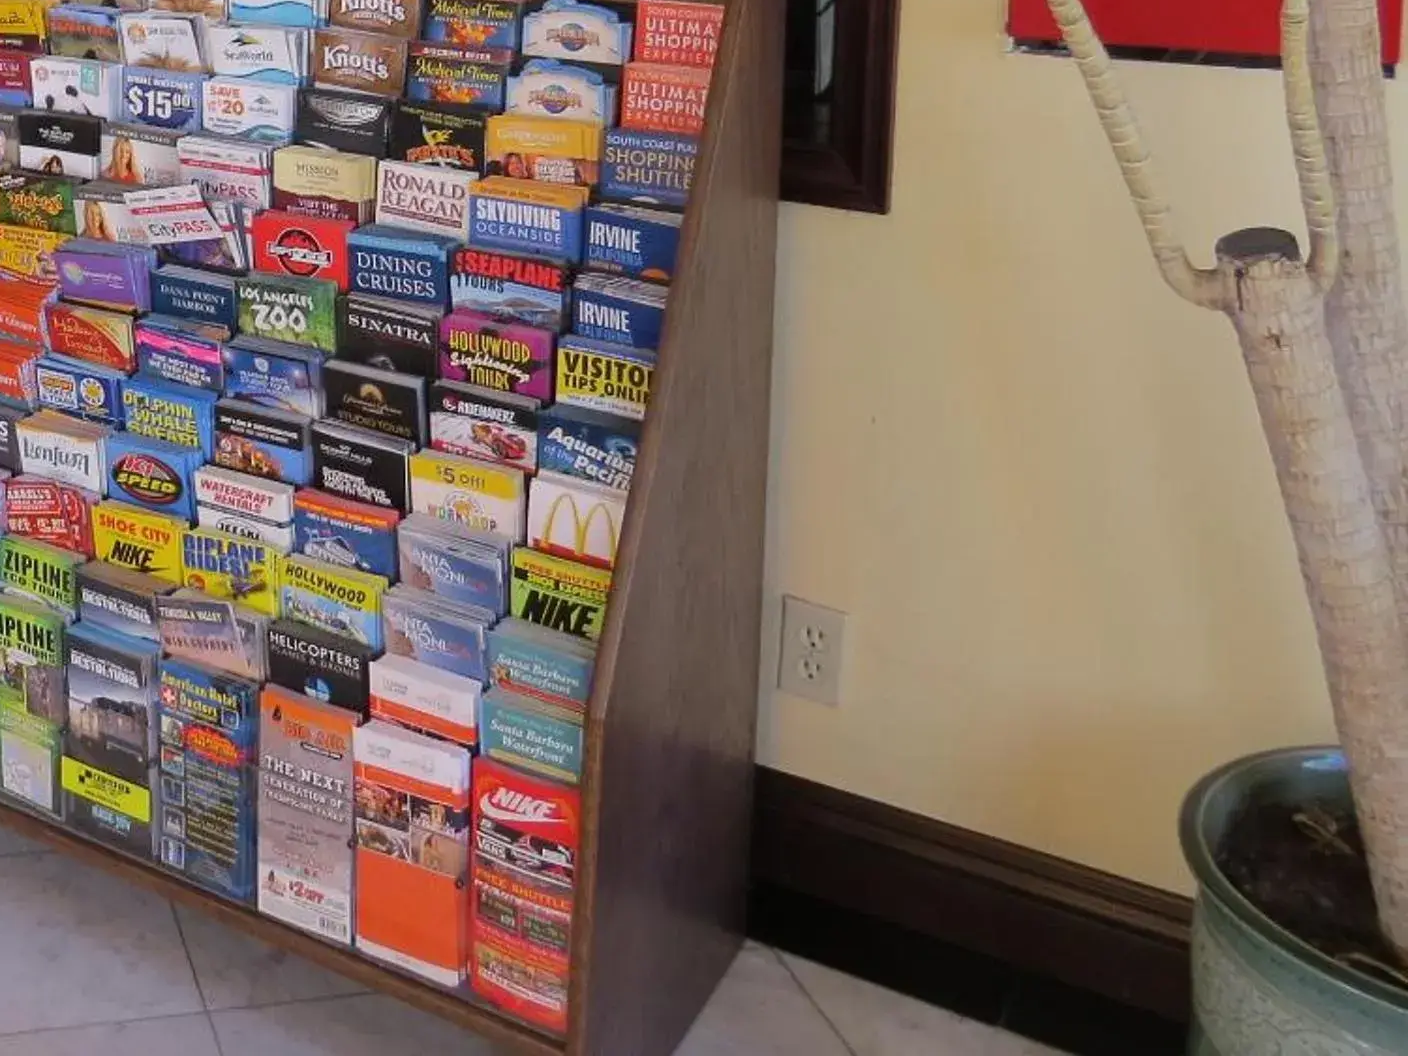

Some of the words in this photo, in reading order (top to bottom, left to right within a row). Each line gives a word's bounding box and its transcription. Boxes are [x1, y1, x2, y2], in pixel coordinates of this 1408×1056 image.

[645, 17, 722, 37] ULTIMA
[224, 48, 274, 62] SeaWorld
[324, 44, 389, 79] Knott's
[607, 134, 641, 146] SOUTH
[383, 169, 465, 198] RONALD
[616, 167, 692, 190] SHUTTLE
[382, 191, 464, 219] REAGAN
[476, 198, 561, 232] SKYDIVING
[148, 219, 213, 237] CityPASS
[476, 220, 561, 244] OCEANSIDE
[589, 220, 641, 253] IRVINE
[357, 252, 432, 277] DINING
[465, 250, 564, 291] SEAPLANE
[192, 290, 227, 306] POINT
[239, 286, 260, 301] LOS
[263, 292, 314, 311] ANGELES
[357, 273, 437, 297] CRUISES
[251, 304, 308, 333] ZOO
[348, 313, 431, 345] SINATRA
[578, 300, 631, 332] IRVINE
[449, 328, 531, 362] HOLLYWOOD
[470, 365, 511, 391] TOURS
[563, 373, 598, 393] TIPS
[123, 390, 193, 418] DOLPHIN
[135, 408, 196, 434] WHALE
[547, 426, 635, 472] Aquarium
[116, 472, 177, 494] SPEED
[200, 478, 274, 506] WATERCRAFT
[213, 493, 262, 514] RENTALS
[99, 512, 137, 538] SHOE
[141, 526, 171, 545] CITY
[112, 540, 155, 569] NIKE
[2, 549, 72, 593] ZIPLINE
[3, 571, 28, 589] ECO
[285, 561, 367, 604] HOLLYWOOD
[521, 589, 599, 635] NIKE
[269, 630, 360, 670] HELICOPTERS
[497, 653, 529, 671] Santa
[531, 661, 579, 688] Barbara
[509, 666, 572, 696] Waterfront
[490, 717, 524, 740] Santa
[526, 728, 574, 754] Barbara
[502, 735, 567, 765] Waterfront
[264, 754, 294, 778] THE
[300, 768, 345, 794] NEXT
[492, 787, 556, 819] NIKE
